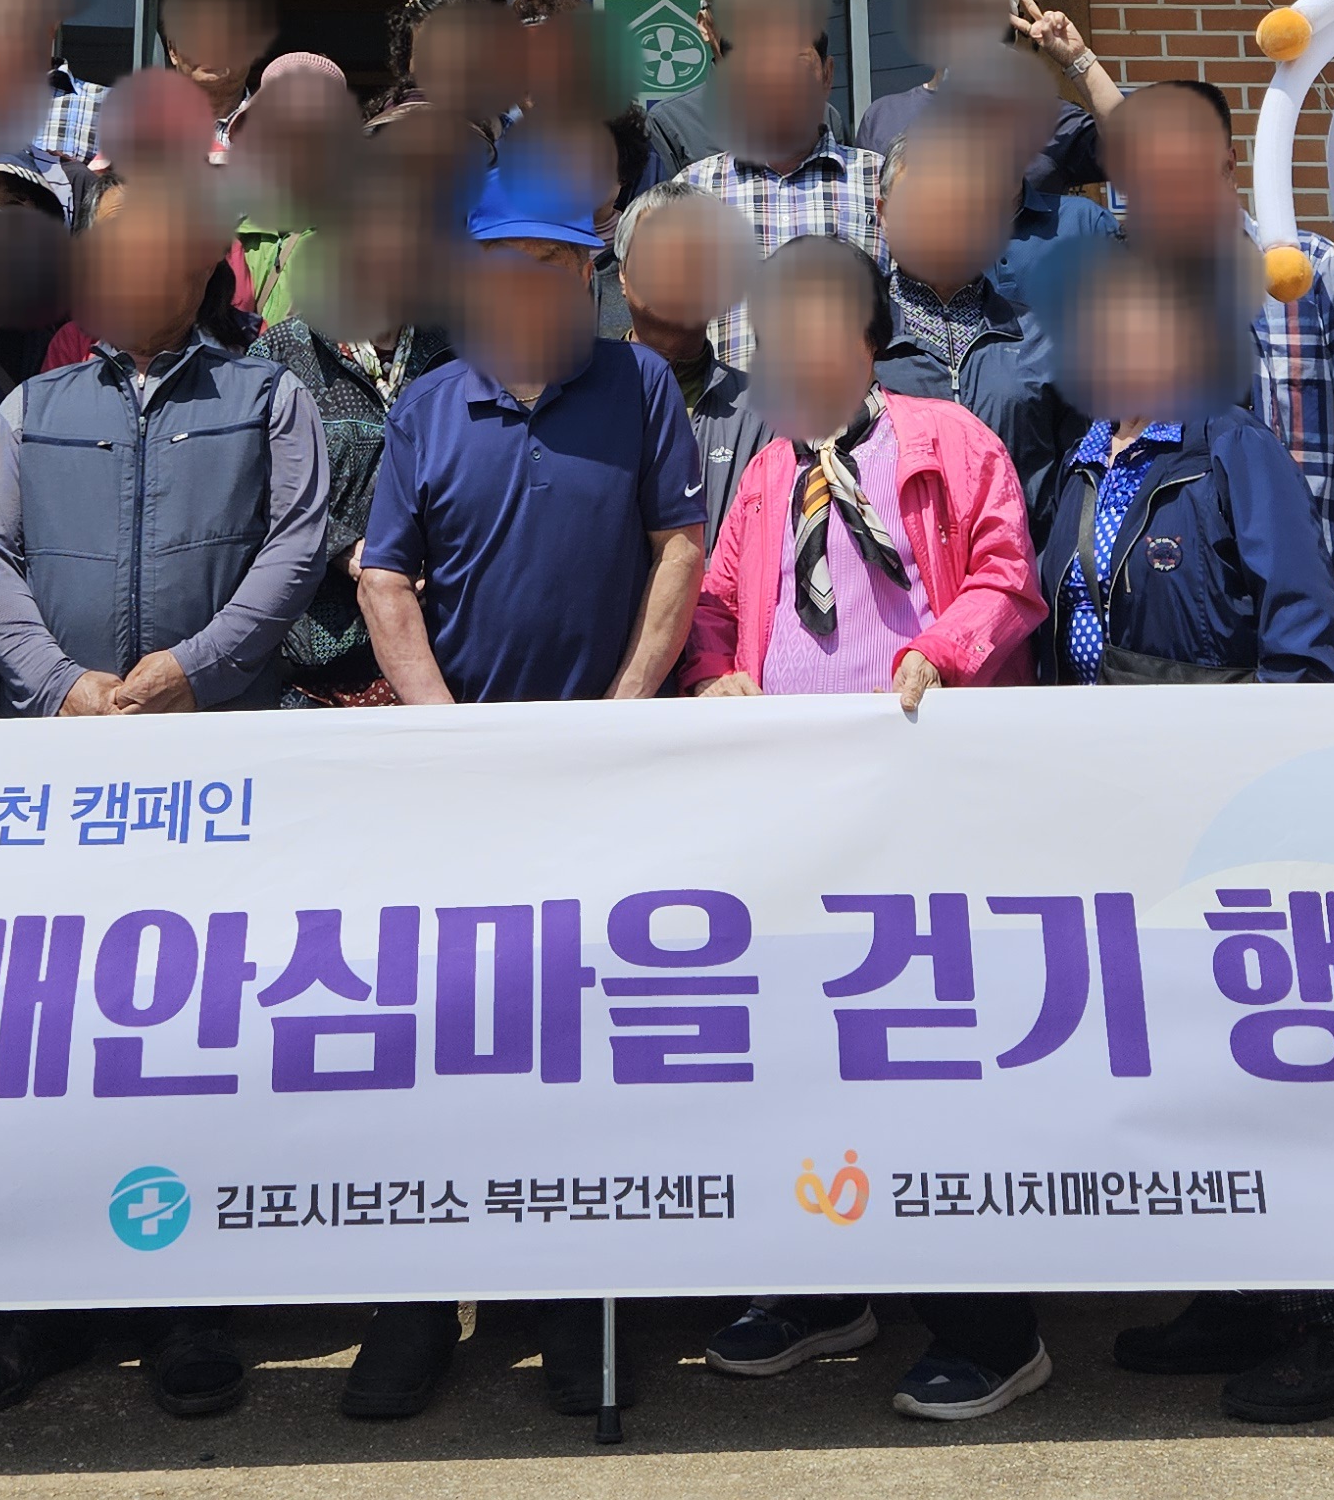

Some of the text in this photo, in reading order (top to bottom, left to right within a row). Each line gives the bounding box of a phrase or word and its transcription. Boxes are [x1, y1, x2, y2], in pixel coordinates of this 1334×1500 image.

[68, 778, 255, 846] 캠페인
[821, 890, 1152, 1082] 걷기
[217, 1175, 736, 1230] 김포시보건소 북부보건센터
[892, 1169, 1268, 1218] 김포시치매안심센터
